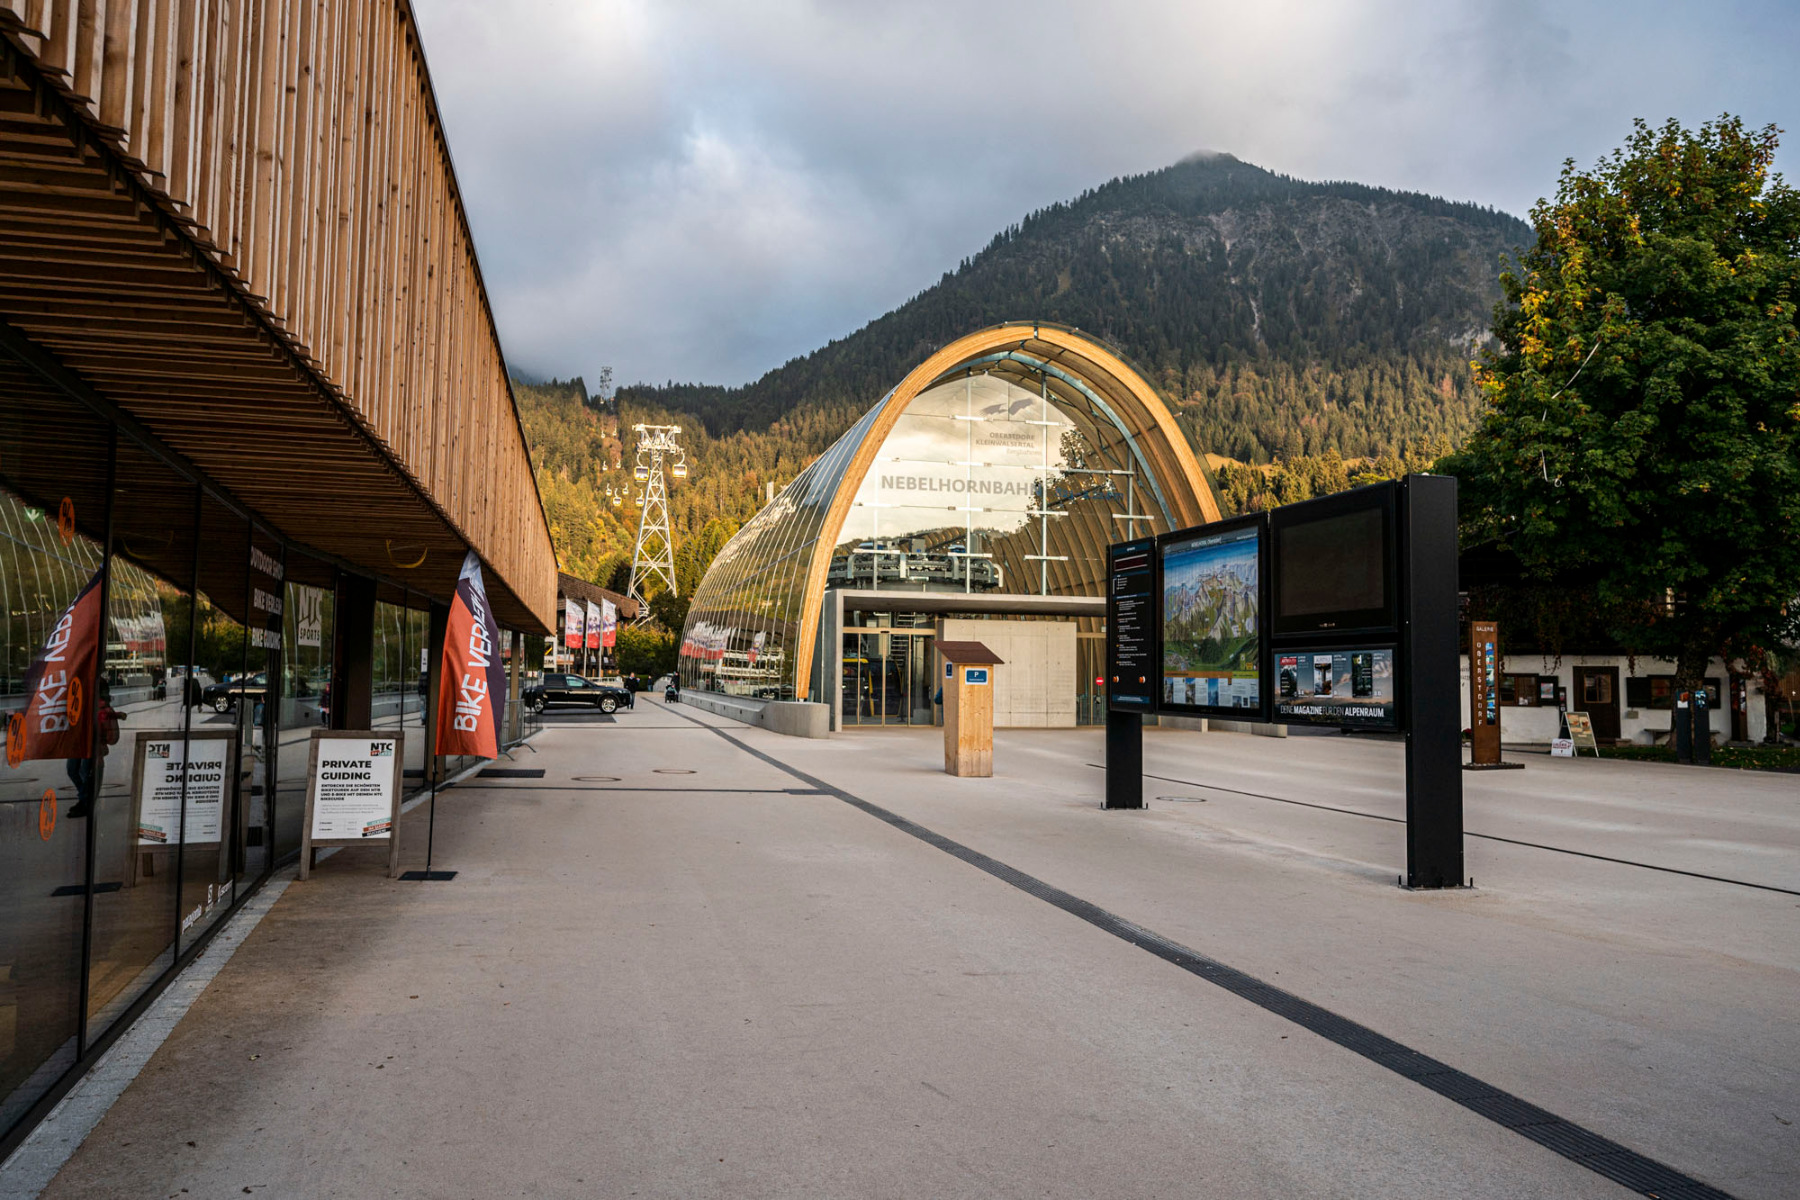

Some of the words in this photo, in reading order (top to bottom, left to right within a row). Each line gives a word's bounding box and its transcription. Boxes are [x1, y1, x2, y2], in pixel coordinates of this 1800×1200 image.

[989, 431, 1035, 441] OBERSTDORF
[975, 439, 1035, 449] KLEINWALSERTAL
[881, 475, 1043, 497] NEBELHORNBAHN
[300, 627, 320, 641] SPORTS
[454, 674, 488, 731] BIKE
[1293, 705, 1323, 715] MAGAZINE
[1344, 707, 1385, 717] ALPENRAUM
[370, 742, 393, 751] NTC
[322, 760, 372, 769] PRIVATE
[321, 772, 371, 780] GUIDING
